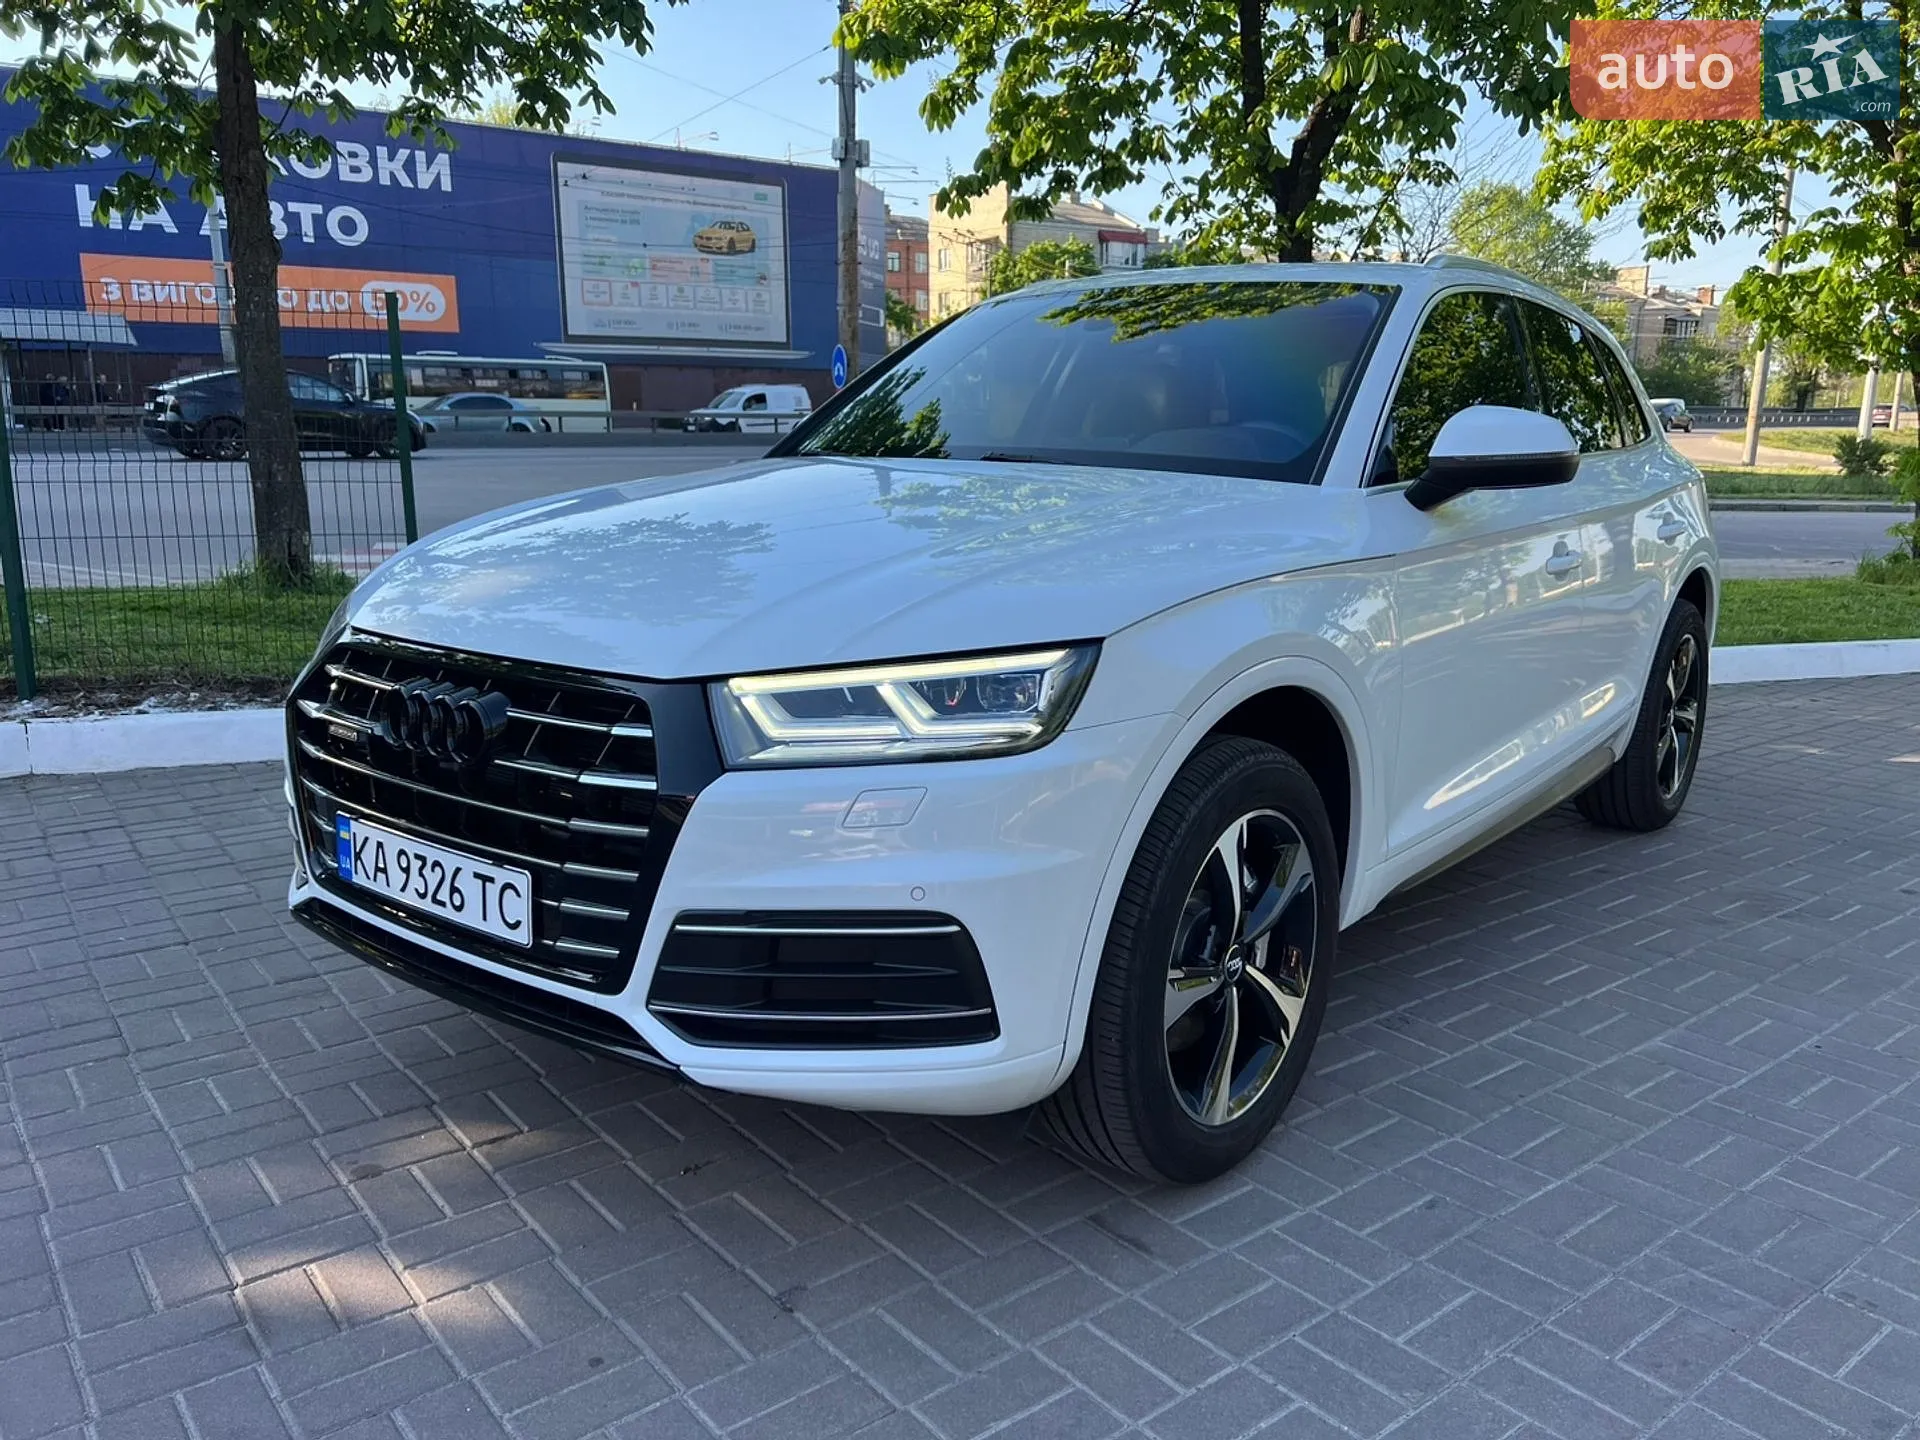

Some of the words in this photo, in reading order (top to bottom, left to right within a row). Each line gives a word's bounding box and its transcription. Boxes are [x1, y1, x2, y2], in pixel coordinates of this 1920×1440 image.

[339, 854, 351, 870] UA
[353, 831, 390, 888] KA
[397, 847, 465, 913] 9326
[473, 871, 522, 931] TC
